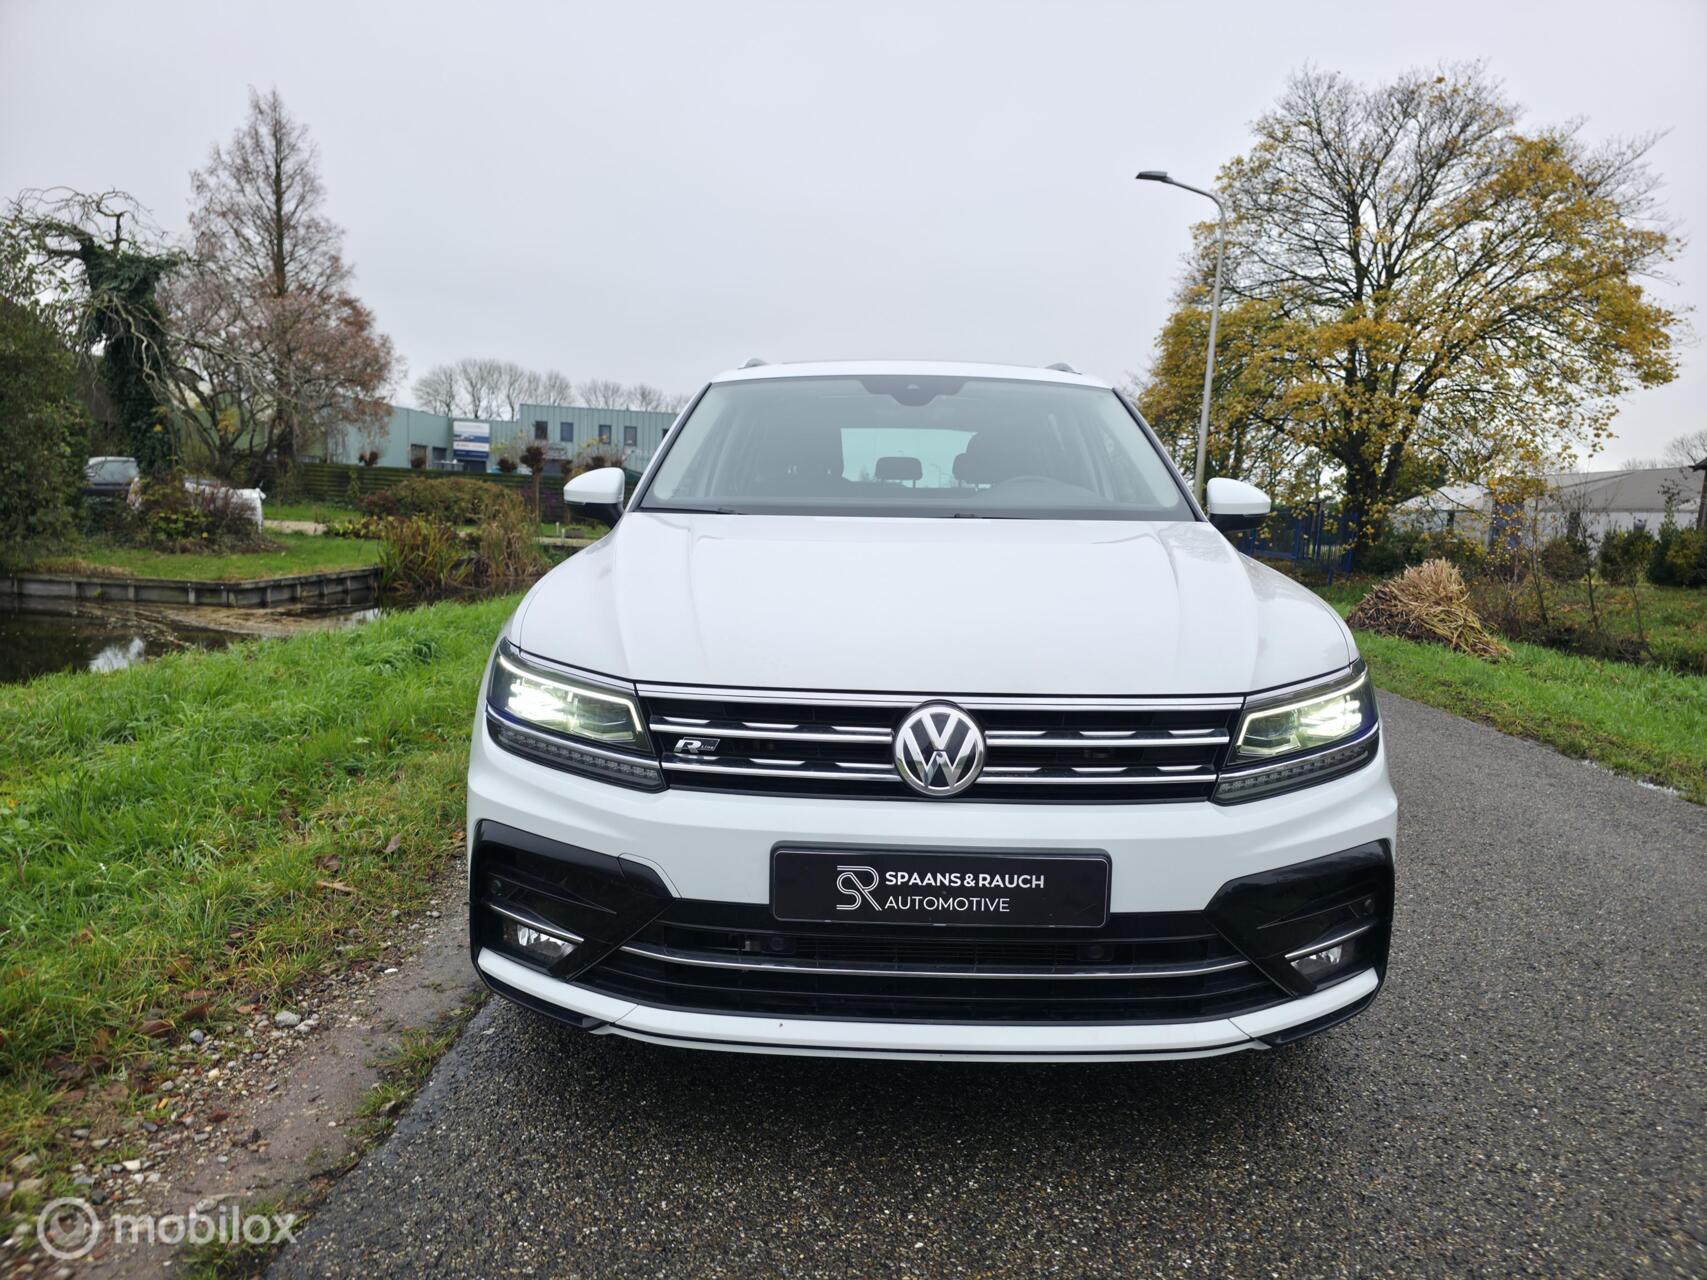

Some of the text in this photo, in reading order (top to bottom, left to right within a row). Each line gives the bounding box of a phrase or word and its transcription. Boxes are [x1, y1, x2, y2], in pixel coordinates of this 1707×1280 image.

[895, 705, 984, 796] VW
[885, 871, 1045, 889] SPAANS&RAUCH
[884, 895, 1010, 912] AUTOMOTIVE
